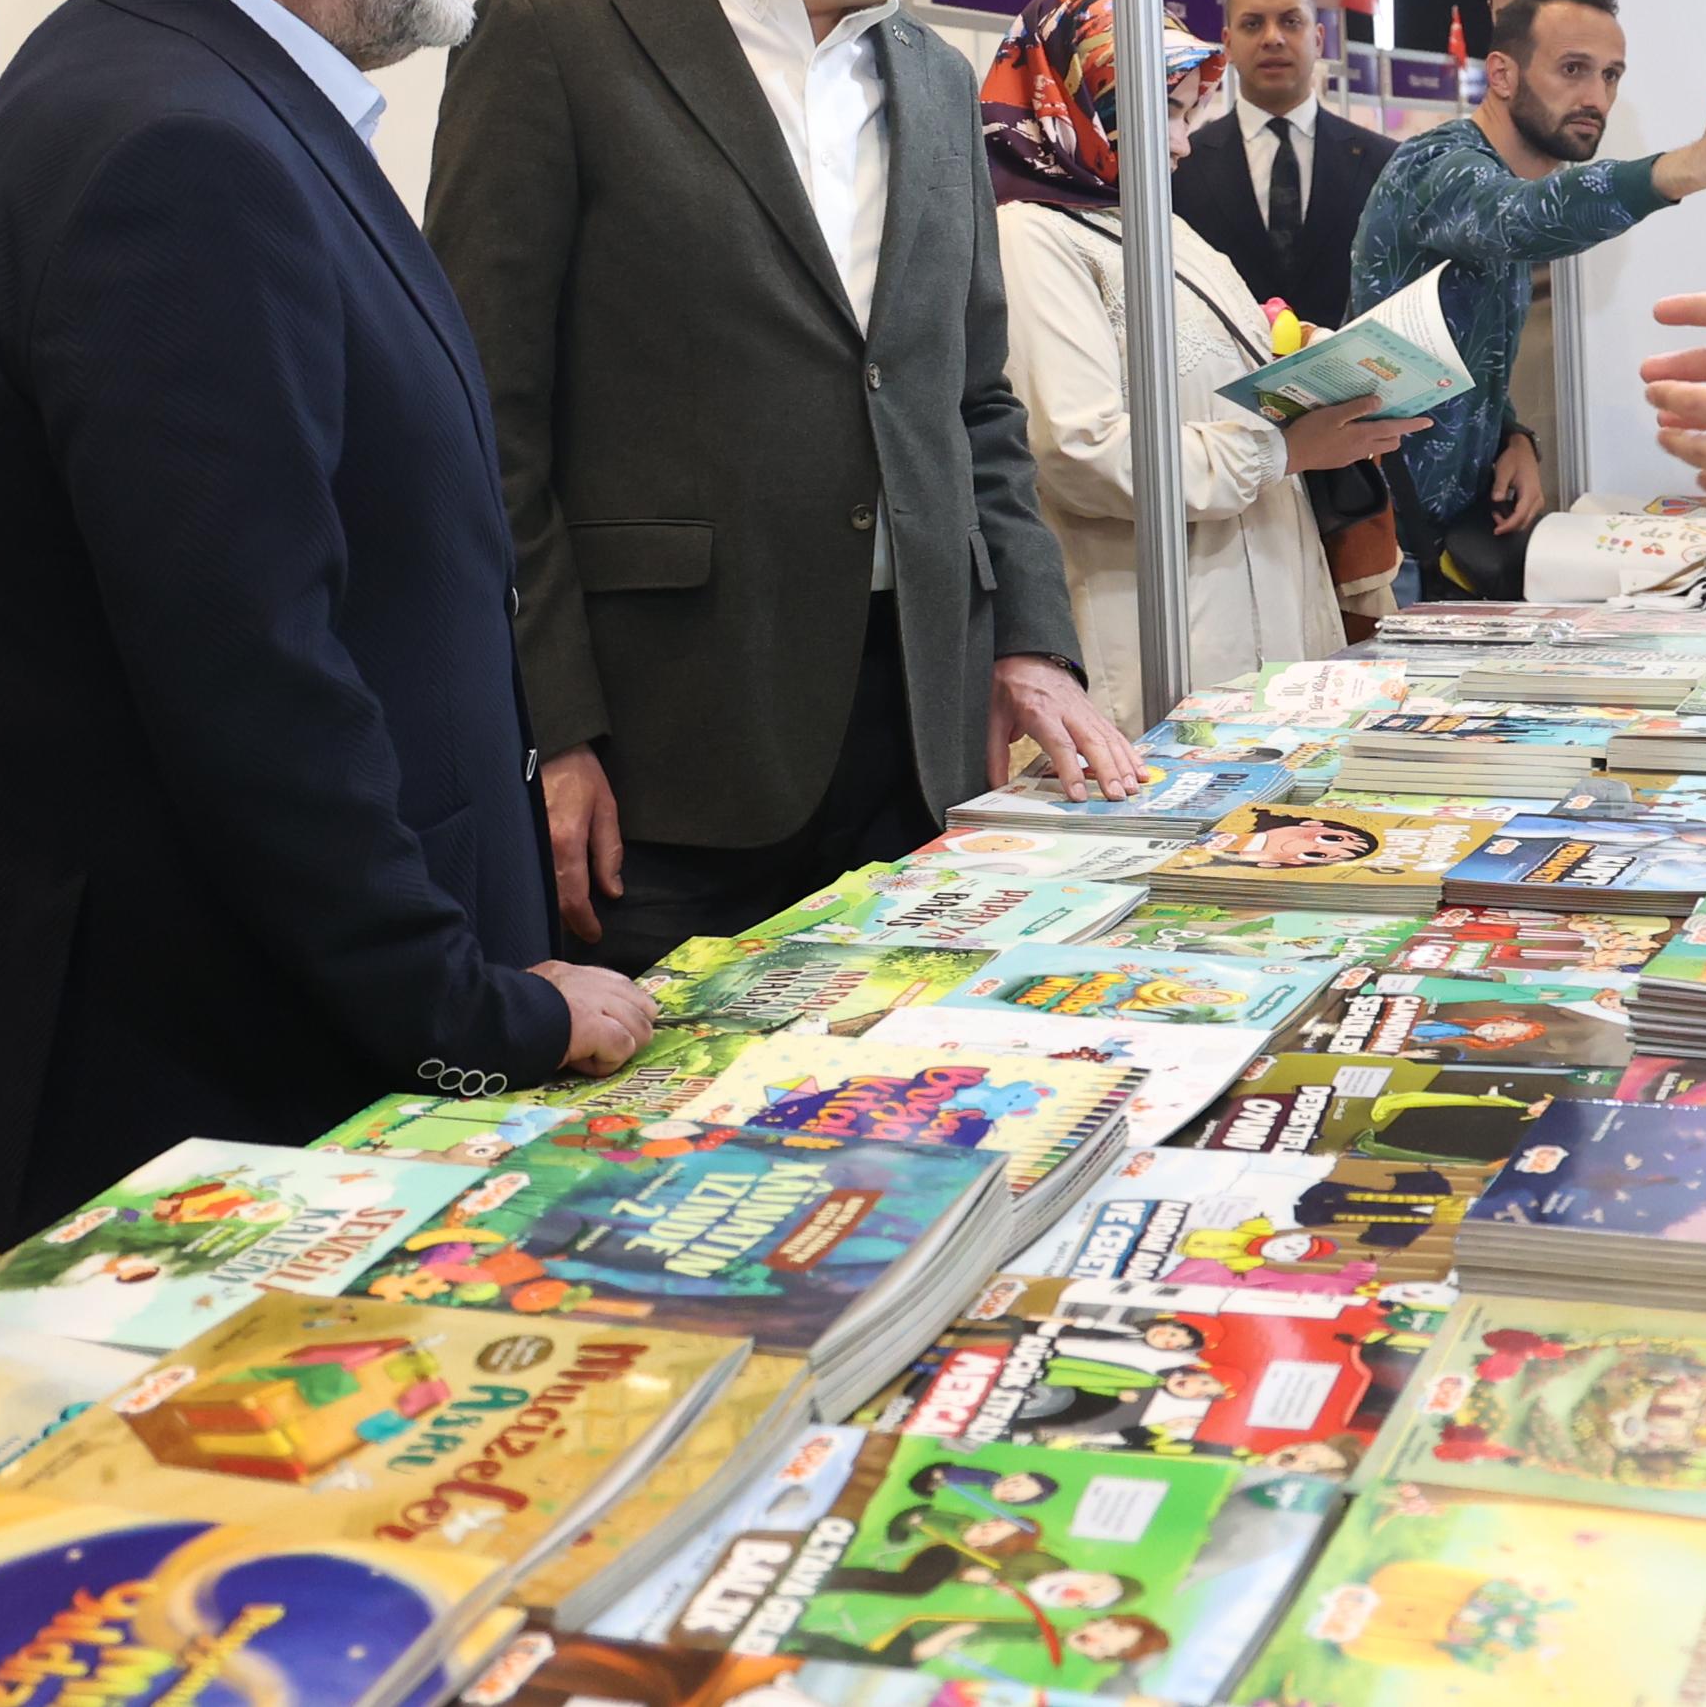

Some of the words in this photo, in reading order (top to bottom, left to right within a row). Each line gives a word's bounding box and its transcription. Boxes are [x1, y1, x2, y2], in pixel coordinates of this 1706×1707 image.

[1574, 846, 1638, 889] KURT
[884, 892, 975, 930] BARIŞ
[947, 888, 1033, 942] PAPATYA
[717, 968, 798, 1015] MASAL
[799, 969, 870, 1014] MASAL
[208, 1208, 343, 1285] KALEM
[908, 1350, 1001, 1436] MERCA
